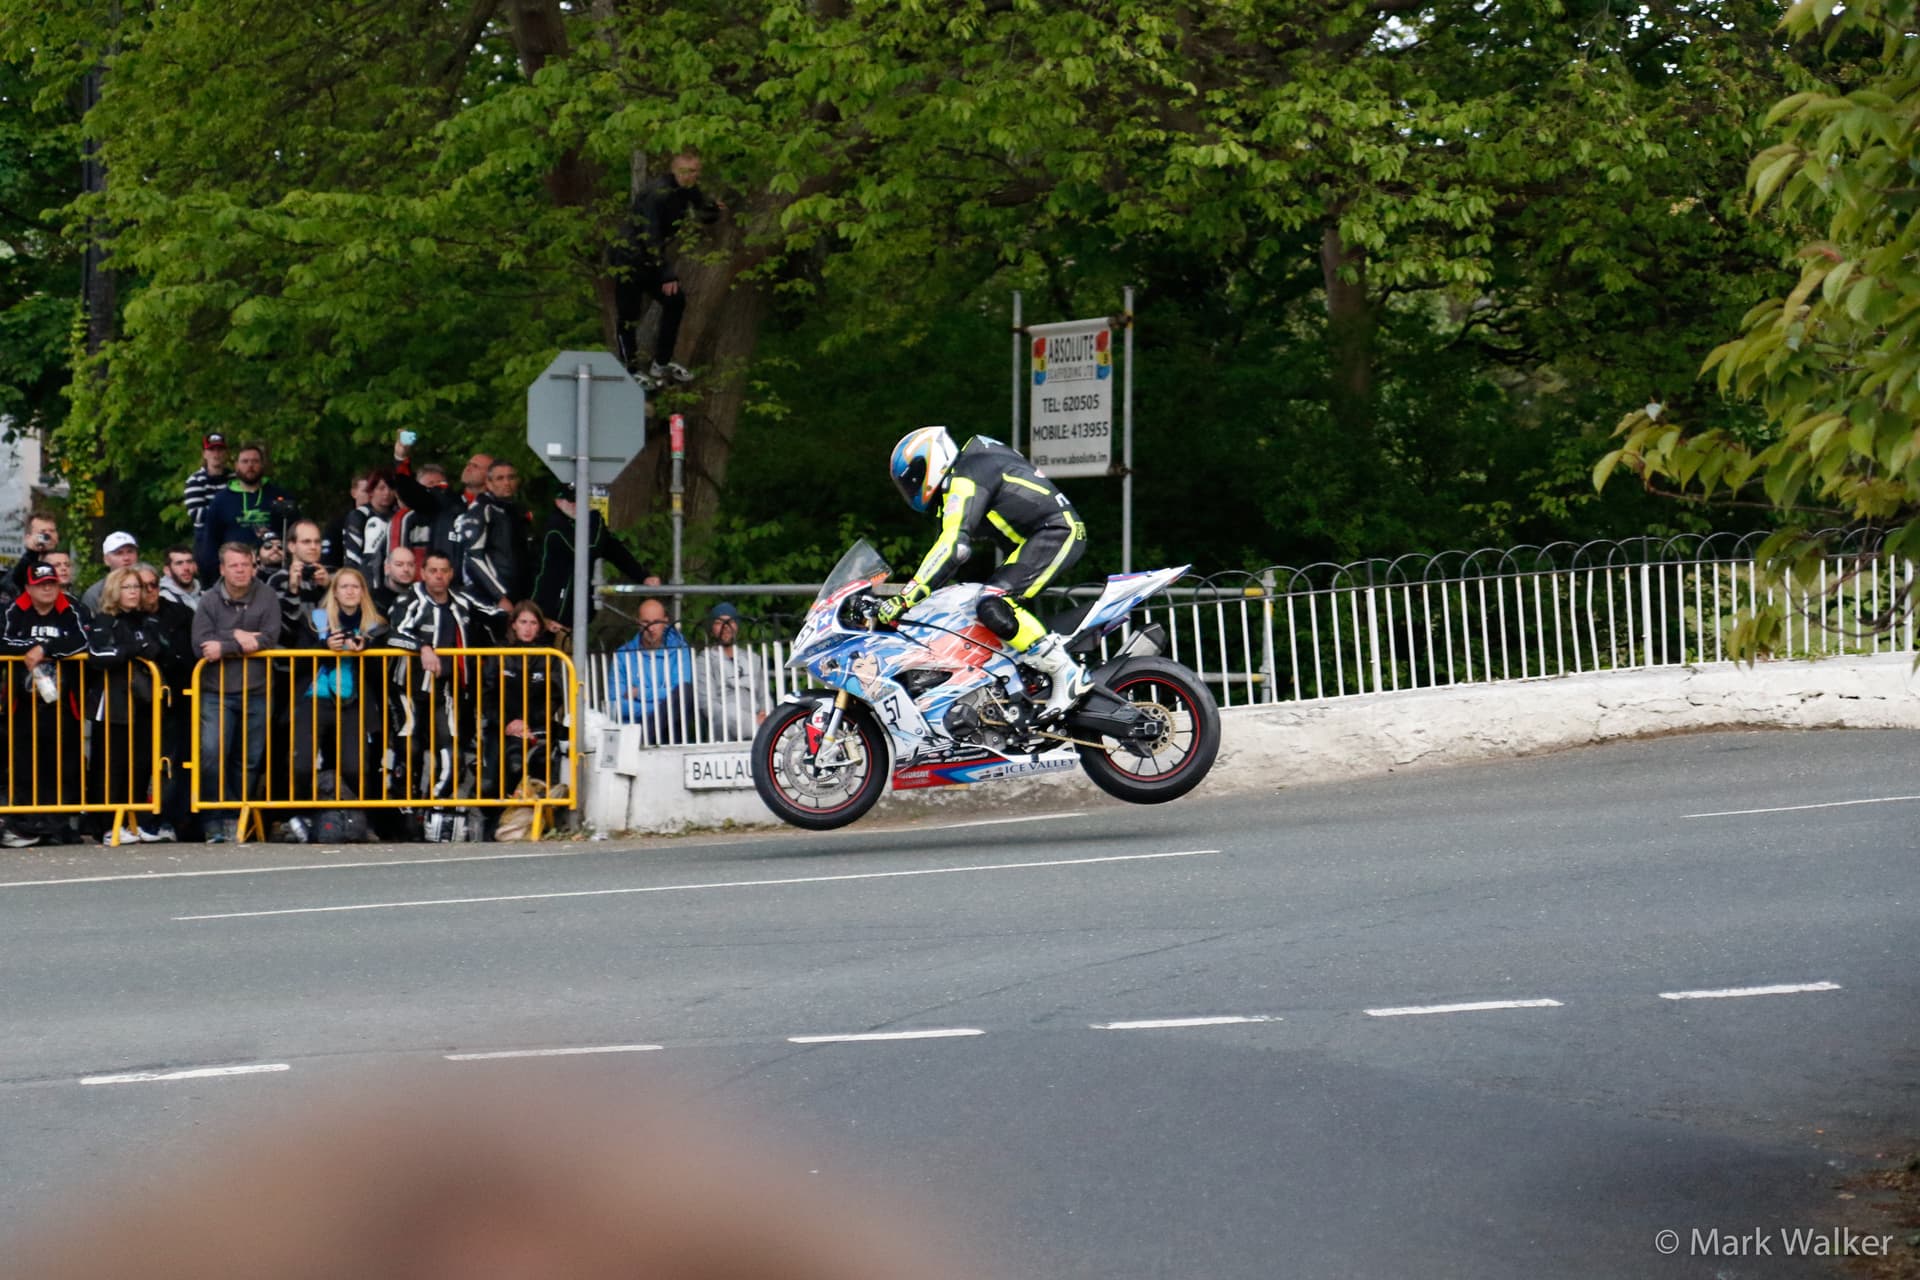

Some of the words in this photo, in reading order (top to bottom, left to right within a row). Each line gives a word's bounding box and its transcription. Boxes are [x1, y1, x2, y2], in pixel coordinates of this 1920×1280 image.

[1048, 334, 1094, 363] ABSOLUTE
[1042, 397, 1060, 413] TEL:
[1062, 394, 1100, 412] 620505
[1032, 423, 1069, 441] MOBILE:
[1071, 421, 1109, 438] 413955
[883, 695, 901, 722] 57
[1005, 764, 1026, 774] ICE
[1028, 759, 1075, 771] VALLEY
